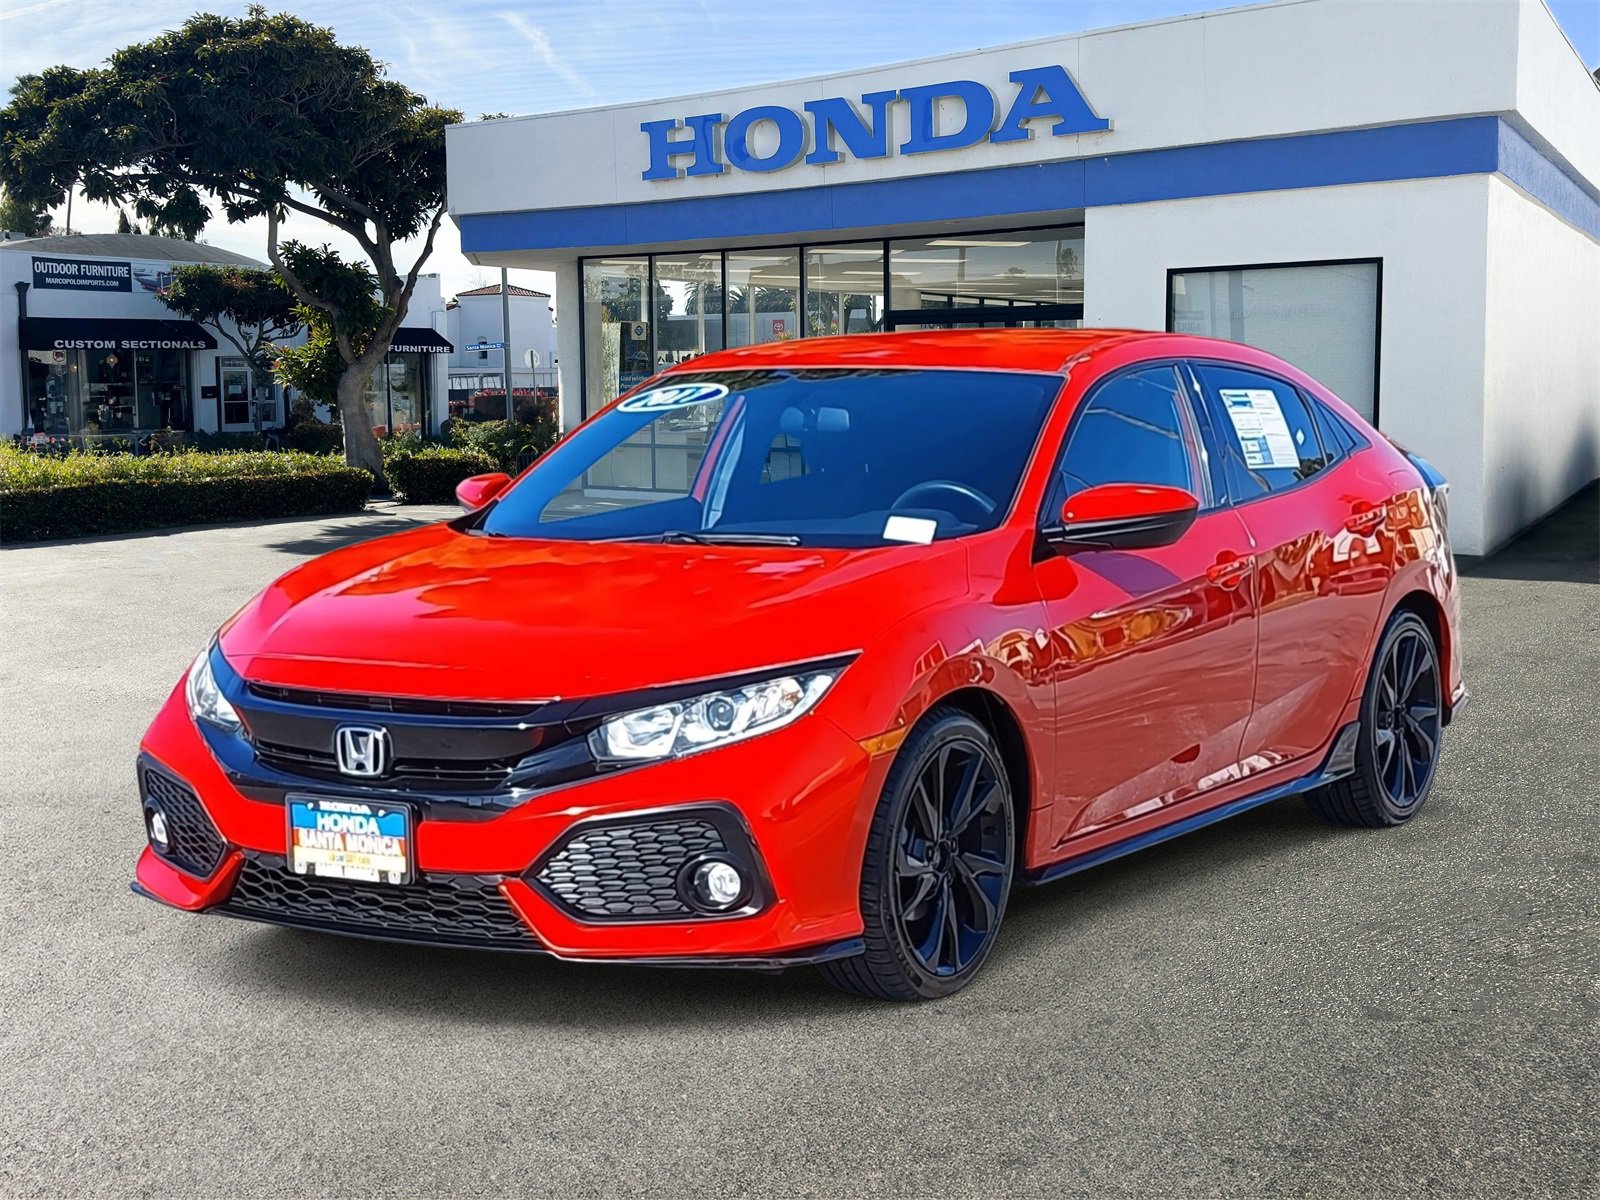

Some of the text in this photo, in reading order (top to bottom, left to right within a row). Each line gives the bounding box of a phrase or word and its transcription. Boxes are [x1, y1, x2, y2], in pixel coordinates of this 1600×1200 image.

[640, 64, 1112, 181] HONDA
[34, 262, 130, 278] OUTDOOR FURNITURE
[45, 277, 119, 287] MARCOPOLOIMPORTS.COM
[54, 339, 206, 349] CUSTOM SECTIONALS
[388, 344, 451, 353] FURNITURE
[316, 812, 382, 837] HONDA
[299, 829, 402, 857] SANTA MONICA
